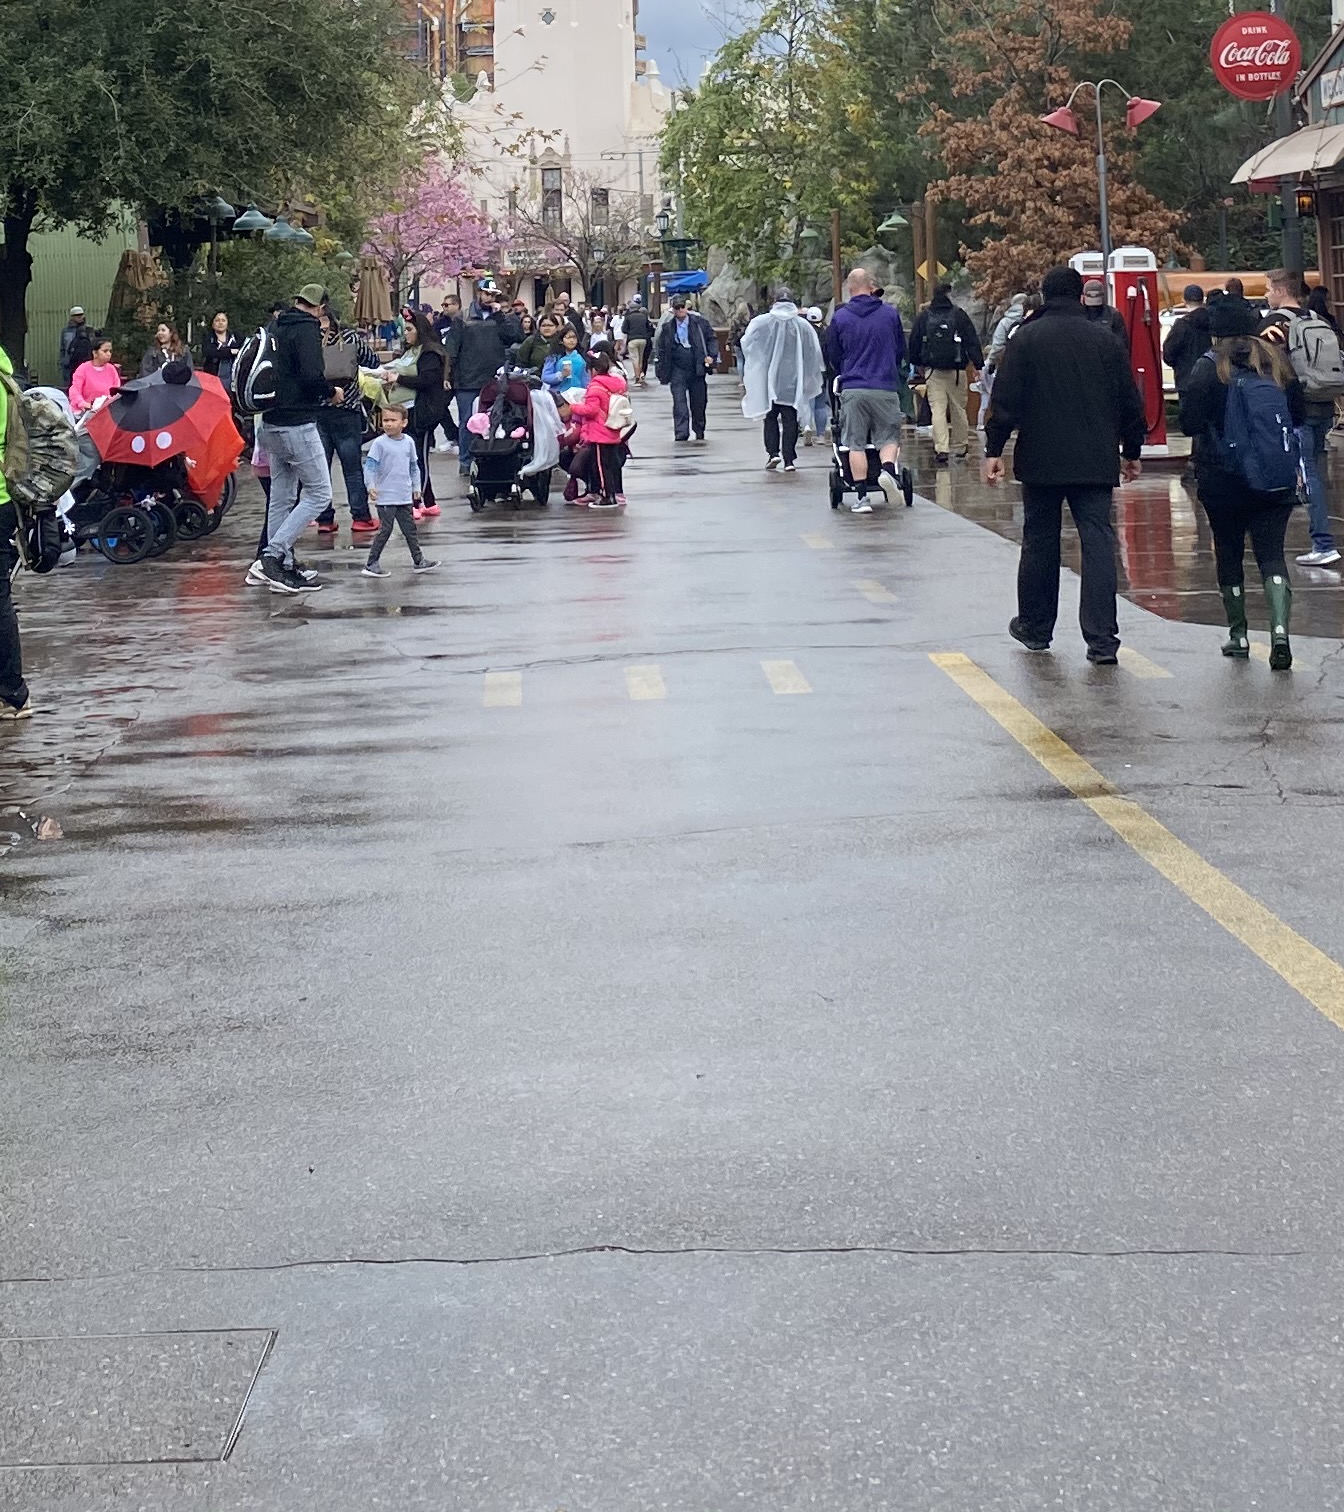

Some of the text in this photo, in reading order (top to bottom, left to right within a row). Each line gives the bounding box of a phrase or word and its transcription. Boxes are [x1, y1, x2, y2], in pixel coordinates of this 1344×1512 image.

[1241, 26, 1268, 35] DRINK
[1236, 71, 1282, 82] IN BOTTLES
